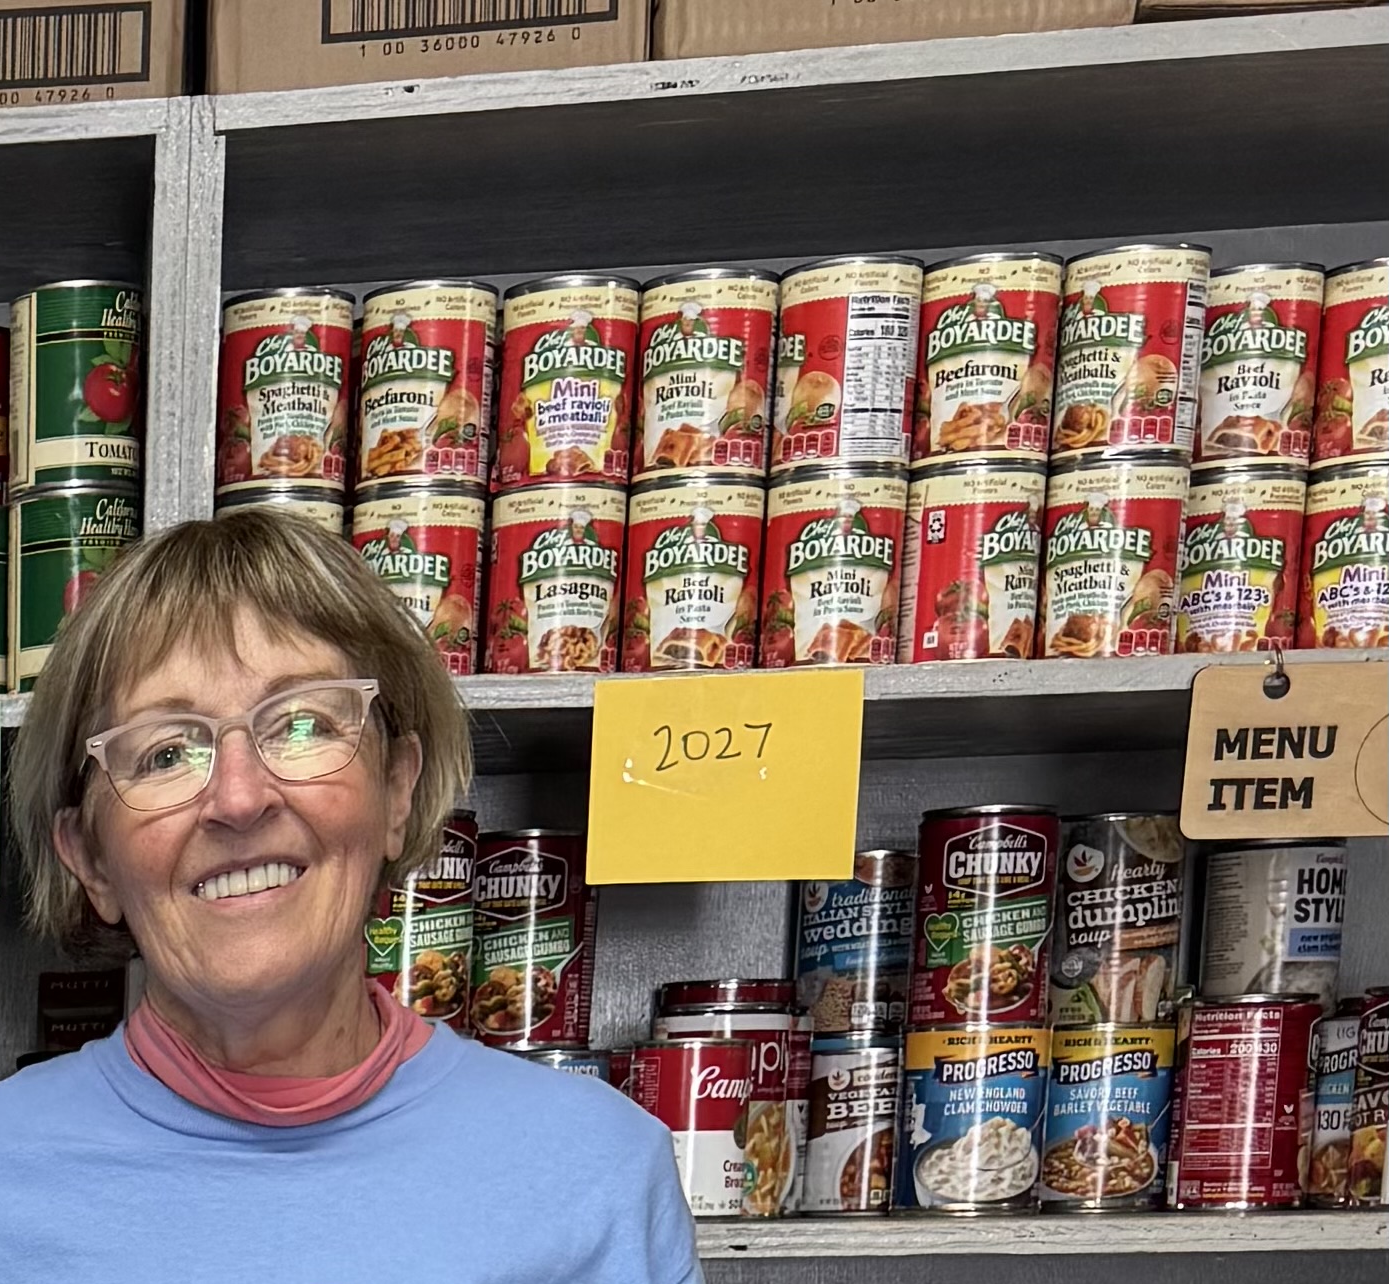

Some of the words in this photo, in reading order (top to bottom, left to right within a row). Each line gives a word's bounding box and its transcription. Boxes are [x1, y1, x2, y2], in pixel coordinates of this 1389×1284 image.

[927, 320, 1035, 361] BOYARDEE
[1201, 326, 1307, 361] BOYARDEE
[245, 352, 343, 381] BOYARDEE
[523, 347, 626, 379] BOYARDEE
[935, 362, 1018, 384] Beefaroni
[1237, 363, 1266, 375] Beef
[553, 379, 597, 399] Mini
[1217, 372, 1281, 393] Ravioli
[258, 387, 318, 403] Spaghetti
[262, 399, 327, 415] Meatballs
[788, 535, 894, 567] BOYARDEE
[1047, 528, 1153, 561] BOYARDEE
[522, 548, 618, 578] BOYARDEE
[535, 582, 608, 603] Lasagna
[682, 576, 710, 589] Beef
[810, 578, 871, 599] Ravioli
[664, 586, 725, 603] Ravioli
[652, 721, 775, 772] 2027
[1213, 725, 1338, 762] MENU
[1207, 777, 1314, 812] ITEM
[948, 852, 1042, 878] CHUNKY
[962, 910, 1028, 925] CHICKEN
[1069, 929, 1111, 946] soup
[942, 1052, 1035, 1081] PROGRESSO
[1059, 1052, 1152, 1079] PROGRESSO
[977, 1089, 1025, 1100] ENGLAND
[944, 1102, 973, 1113] CLAM
